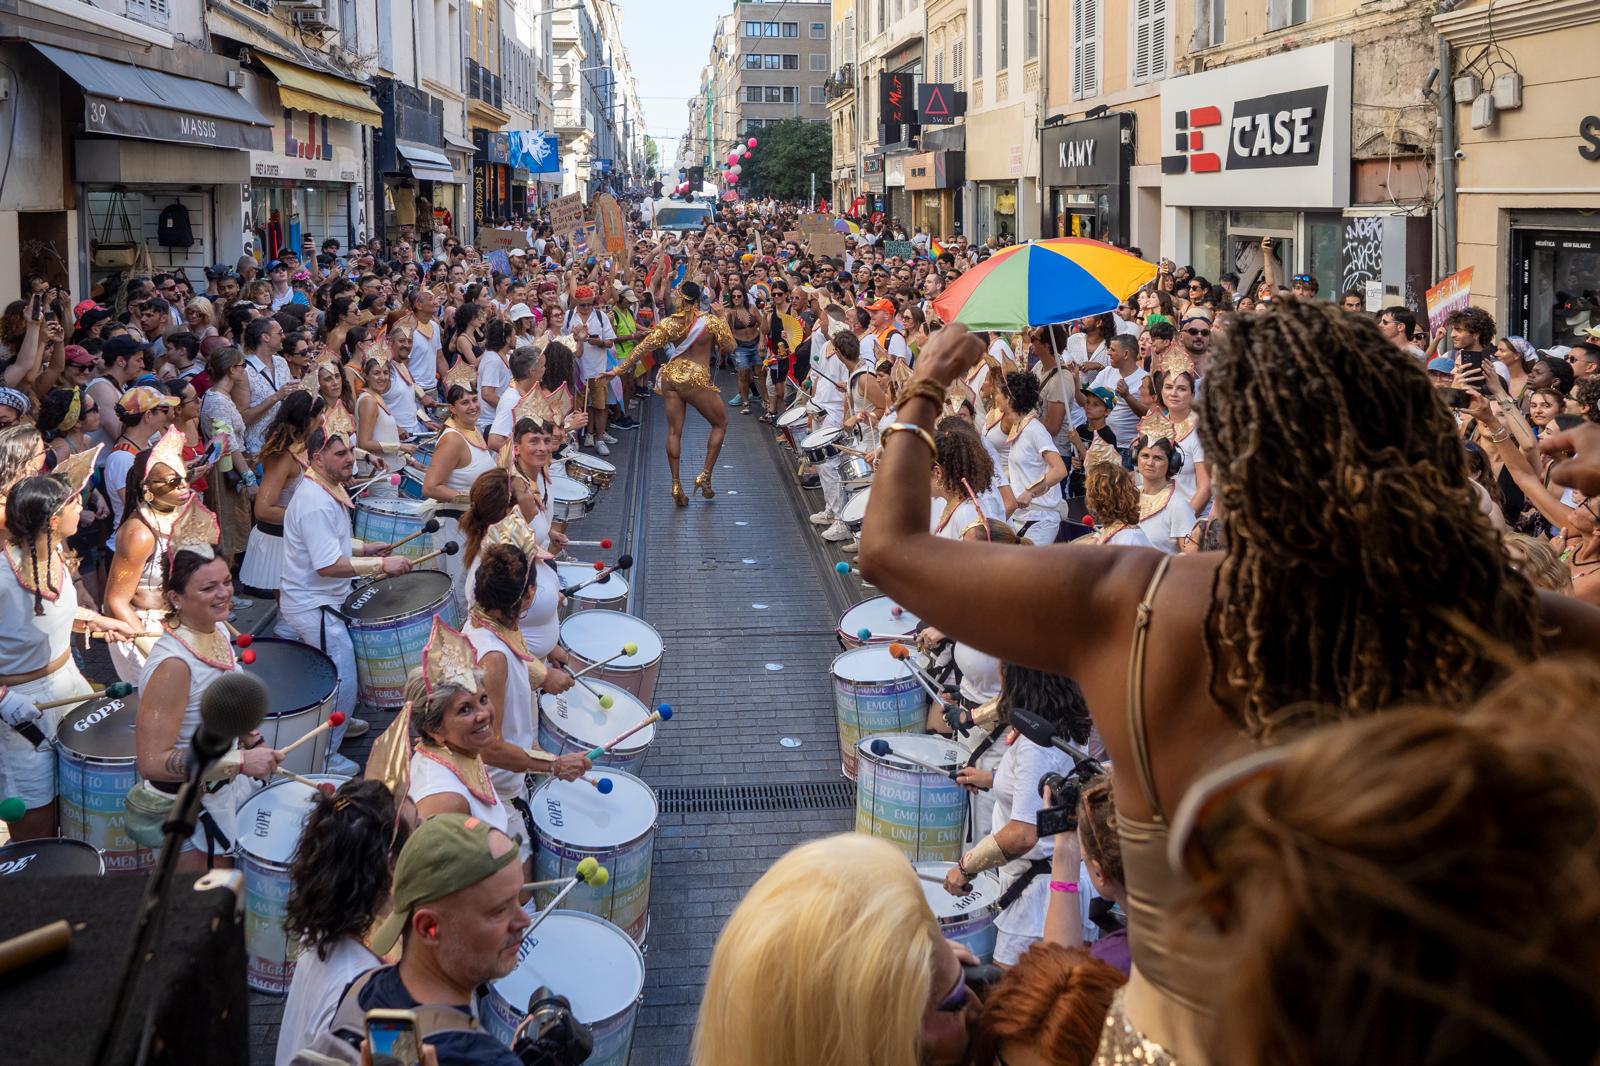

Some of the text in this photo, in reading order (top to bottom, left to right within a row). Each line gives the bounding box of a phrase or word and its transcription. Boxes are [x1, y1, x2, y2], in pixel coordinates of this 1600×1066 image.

[90, 103, 107, 125] 39
[180, 117, 217, 139] MASSIS
[1232, 107, 1313, 158] CASE
[1059, 139, 1094, 168] KAMY
[351, 586, 380, 611] GOPE
[74, 698, 125, 732] GOPE
[928, 791, 959, 804] AMOR
[254, 808, 272, 838] GOPE
[547, 798, 565, 828] GOPE
